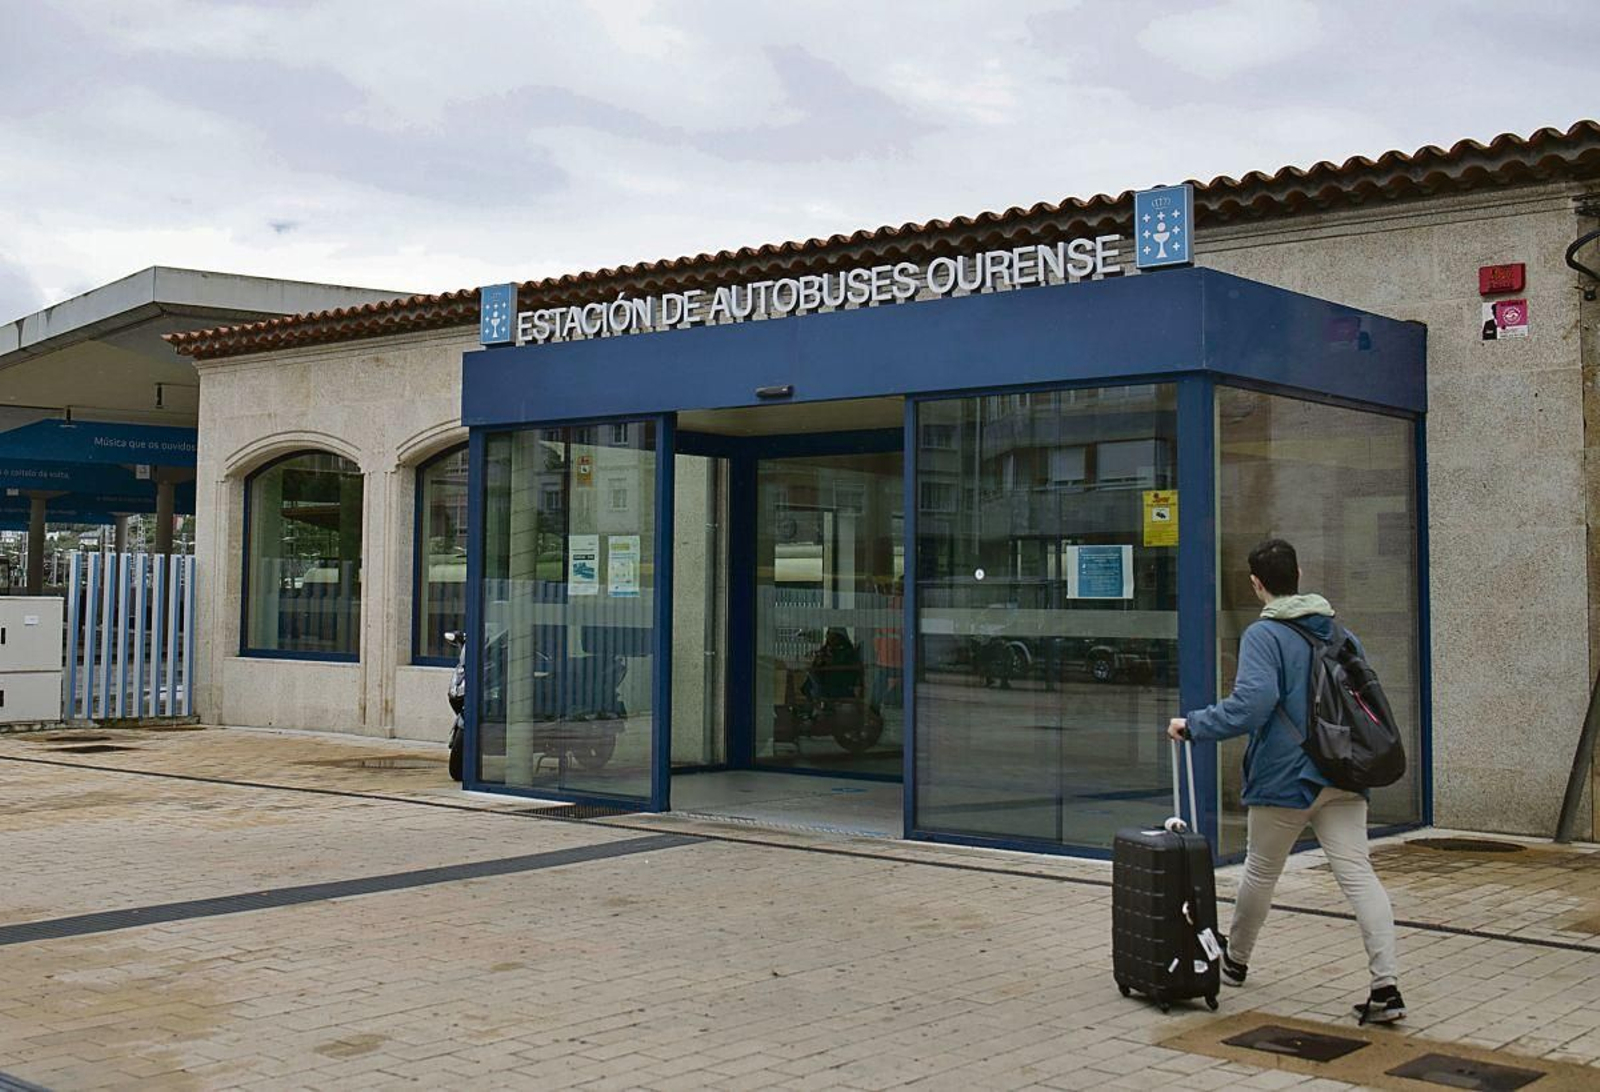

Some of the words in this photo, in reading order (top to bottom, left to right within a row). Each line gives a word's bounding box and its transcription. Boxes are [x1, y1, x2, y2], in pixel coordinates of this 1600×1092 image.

[516, 292, 653, 342] ESTACIÓN
[661, 290, 707, 325] DE
[709, 262, 920, 320] AUTOBUSES
[926, 234, 1123, 294] OURENSE
[94, 436, 127, 448] Música
[128, 440, 146, 450] que
